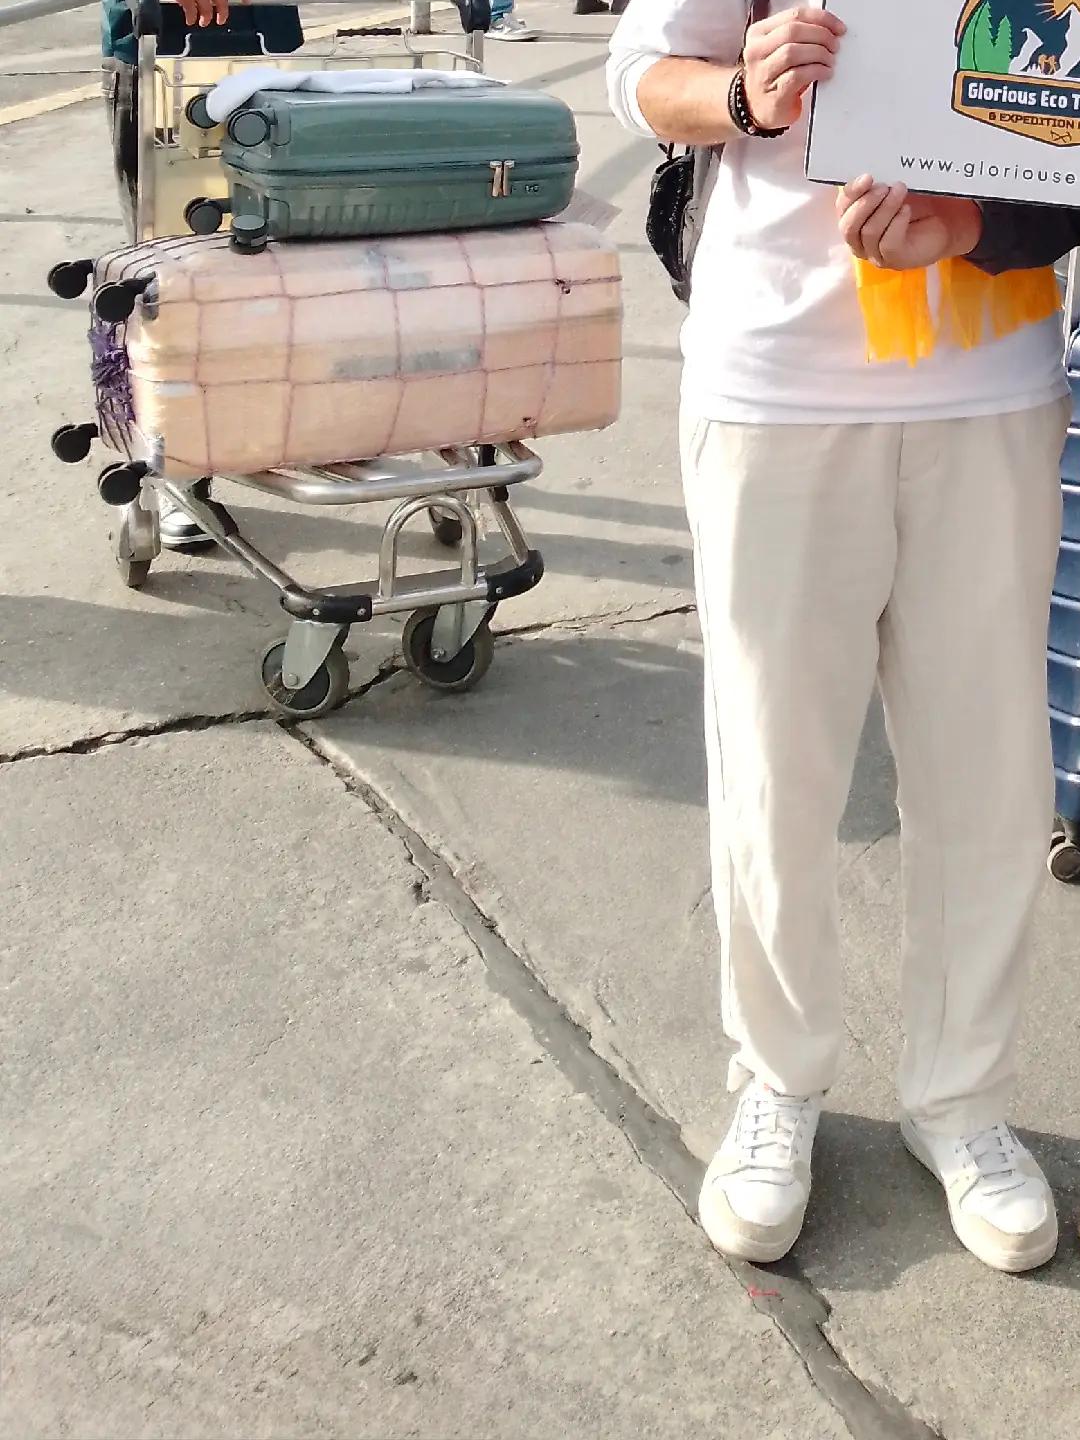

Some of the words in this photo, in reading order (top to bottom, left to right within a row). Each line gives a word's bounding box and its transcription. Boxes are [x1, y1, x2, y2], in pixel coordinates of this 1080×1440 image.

[968, 82, 1037, 106] Glorious
[1040, 93, 1068, 109] Eco
[999, 113, 1075, 130] EXPEDITION
